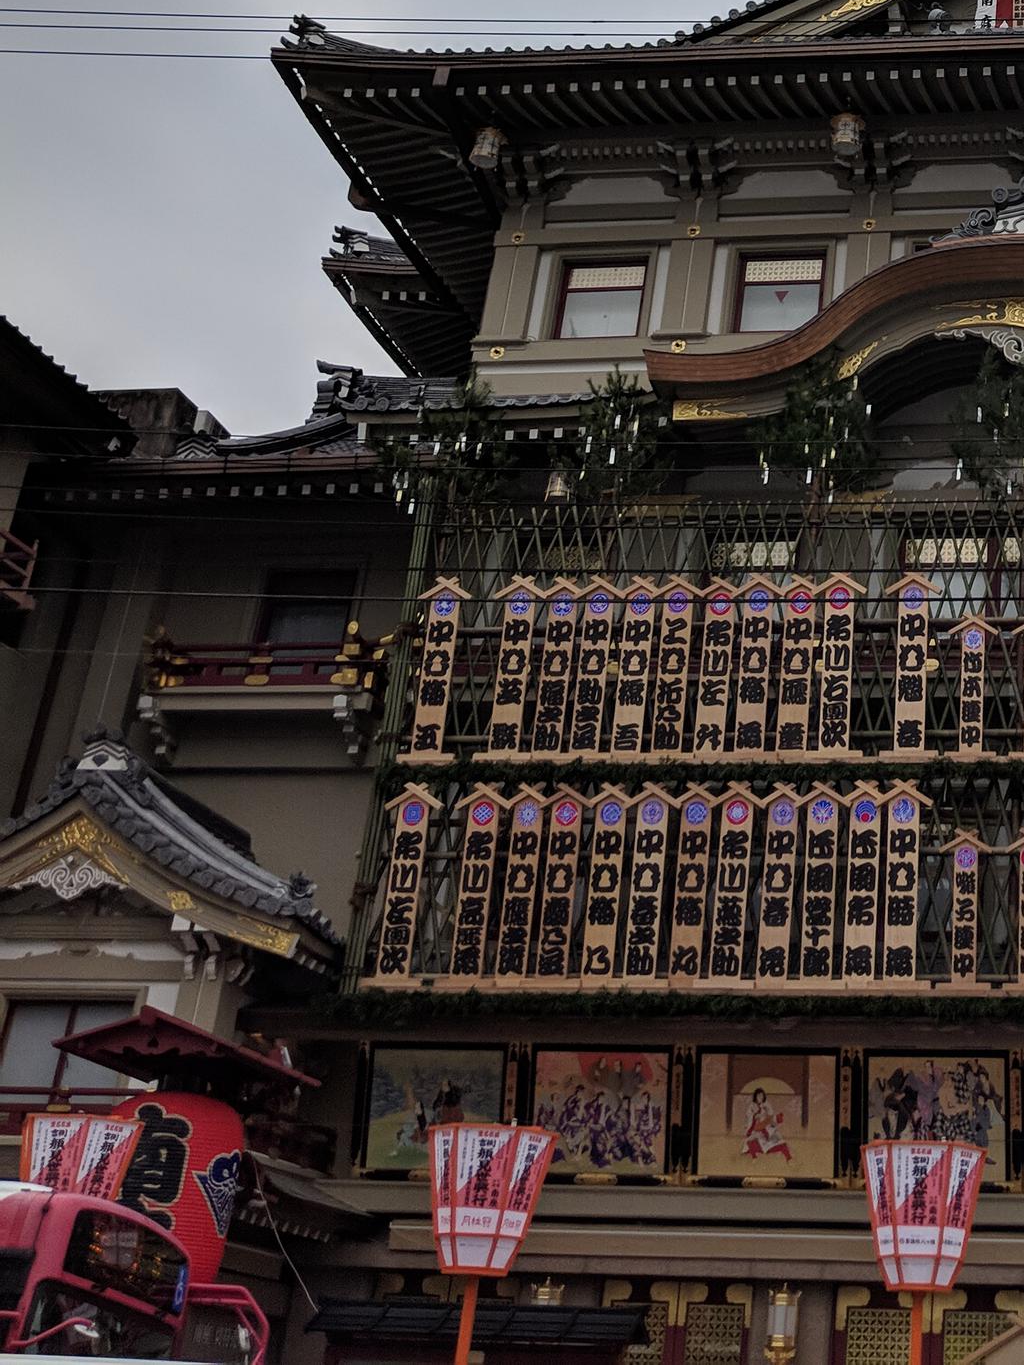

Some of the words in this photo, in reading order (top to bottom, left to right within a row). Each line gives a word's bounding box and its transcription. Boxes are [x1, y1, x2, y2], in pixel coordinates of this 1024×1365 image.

[44, 1128, 68, 1190] 吉例顔見世興
